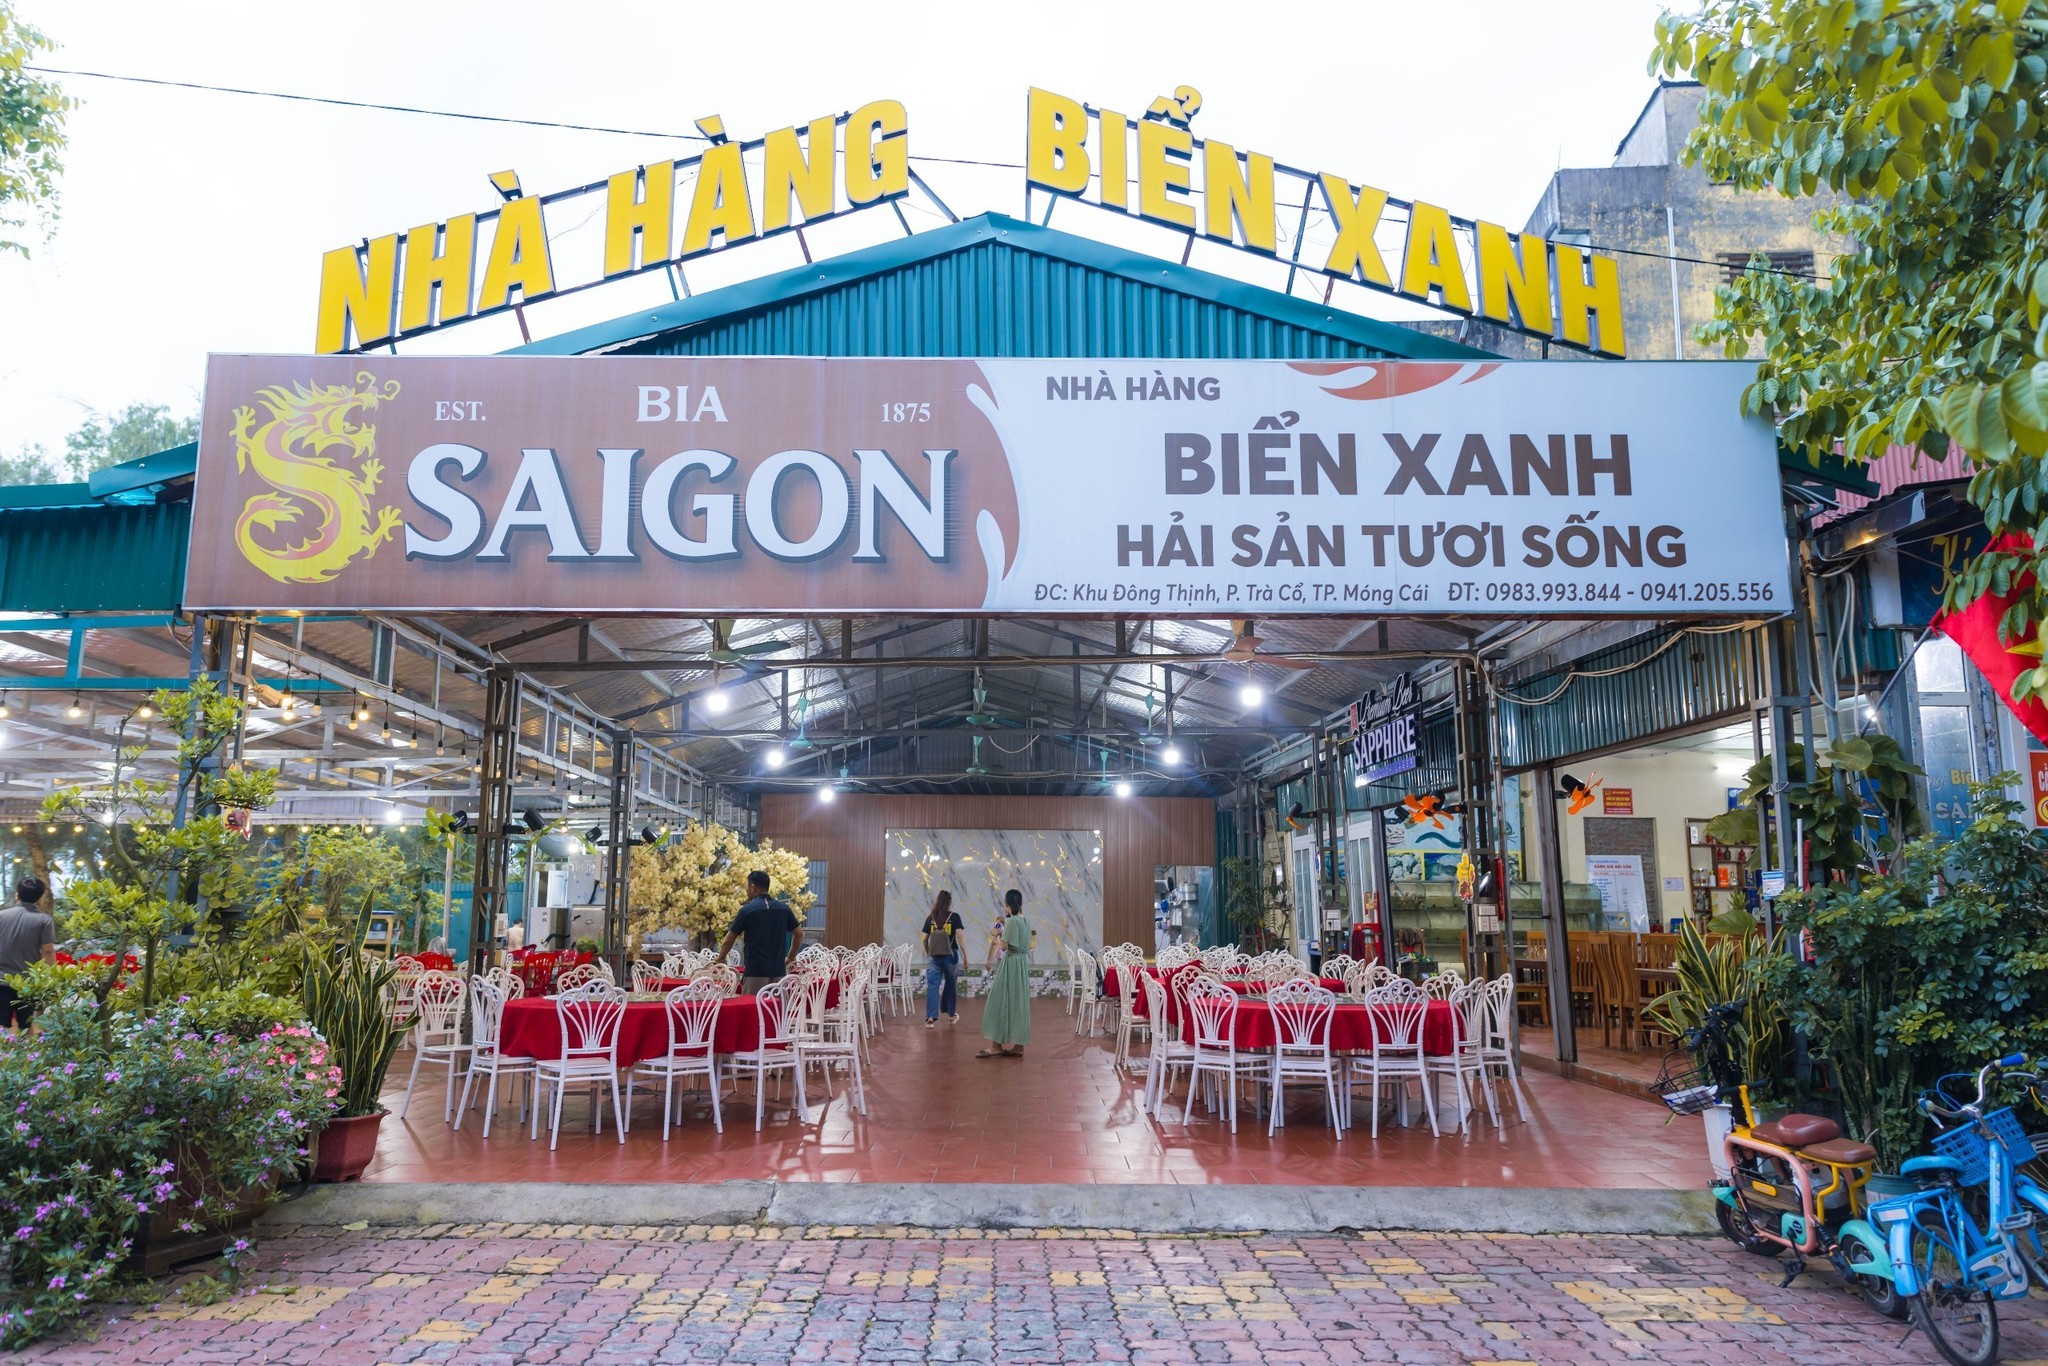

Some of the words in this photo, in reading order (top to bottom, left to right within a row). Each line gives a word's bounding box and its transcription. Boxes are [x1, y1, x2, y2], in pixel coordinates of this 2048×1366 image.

[316, 169, 555, 353] NHÀ
[603, 99, 909, 280] HÀNG
[1027, 85, 1277, 254] BIỂN
[1317, 171, 1626, 358] XANH
[434, 400, 488, 422] EST.
[636, 384, 729, 423] BIA
[880, 401, 931, 423] 1875
[1047, 374, 1117, 401] NHÀ
[1126, 373, 1221, 401] HÀNG
[1164, 410, 1358, 496] BIỂN
[1382, 433, 1632, 497] XANH
[402, 443, 956, 560] SAIGON
[1116, 509, 1214, 567] HẢI
[1231, 509, 1346, 568] SẢN
[1361, 521, 1506, 568] TƯƠI
[1521, 509, 1688, 569] SỐNG
[1034, 583, 1068, 602] ĐC:
[1073, 583, 1108, 602] Khu
[1113, 583, 1161, 605] Đông
[1167, 583, 1220, 607] Thịnh,
[1226, 583, 1241, 602] P.
[1246, 583, 1274, 602] Trà
[1278, 581, 1307, 605] Cổ,
[1312, 583, 1338, 602] TP.
[1342, 583, 1394, 606] Móng
[1398, 583, 1429, 602] Cái
[1447, 582, 1480, 602] ĐT:
[1485, 581, 1622, 603] 0983.993.844
[1640, 581, 1774, 602] 0941.205.556
[1358, 690, 1392, 728] Premium
[1391, 672, 1413, 717] Beer
[1353, 713, 1417, 771] SAPPHIRE
